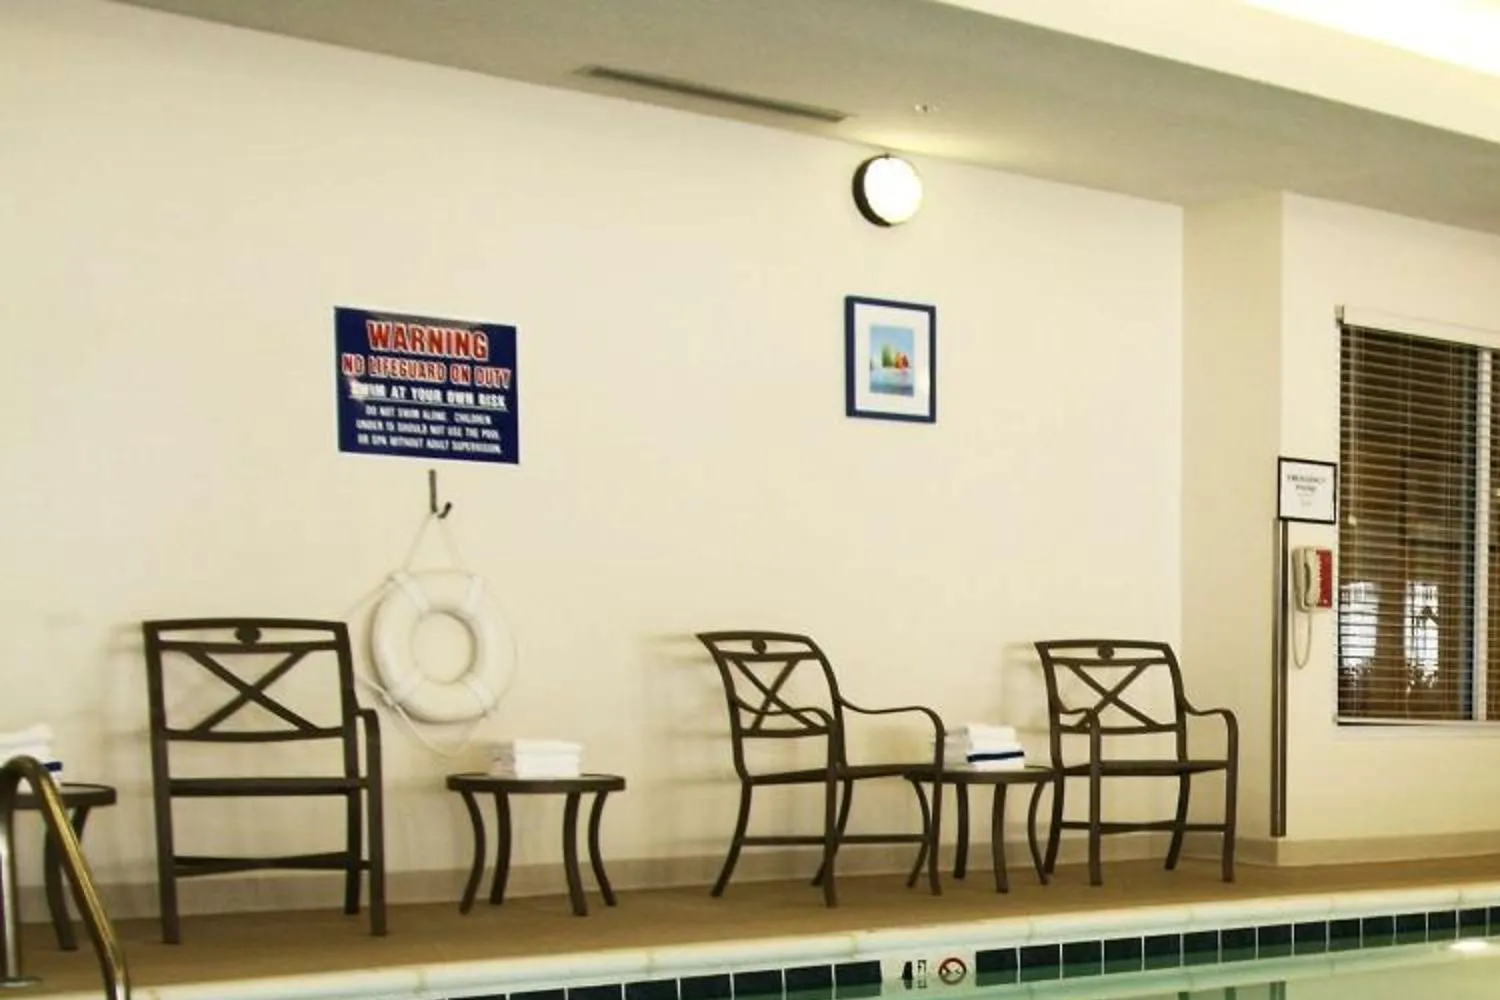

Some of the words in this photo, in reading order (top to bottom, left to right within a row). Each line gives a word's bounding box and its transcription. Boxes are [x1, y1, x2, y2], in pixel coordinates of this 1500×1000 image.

[366, 319, 488, 361] WARNING
[342, 353, 365, 377] NO
[368, 355, 447, 383] LIFEGUARD
[451, 363, 471, 386] ON
[474, 366, 512, 389] DUTY
[391, 385, 406, 399] AT
[411, 387, 442, 402] YOUR
[447, 389, 474, 405] OWN
[478, 393, 506, 408] RISK
